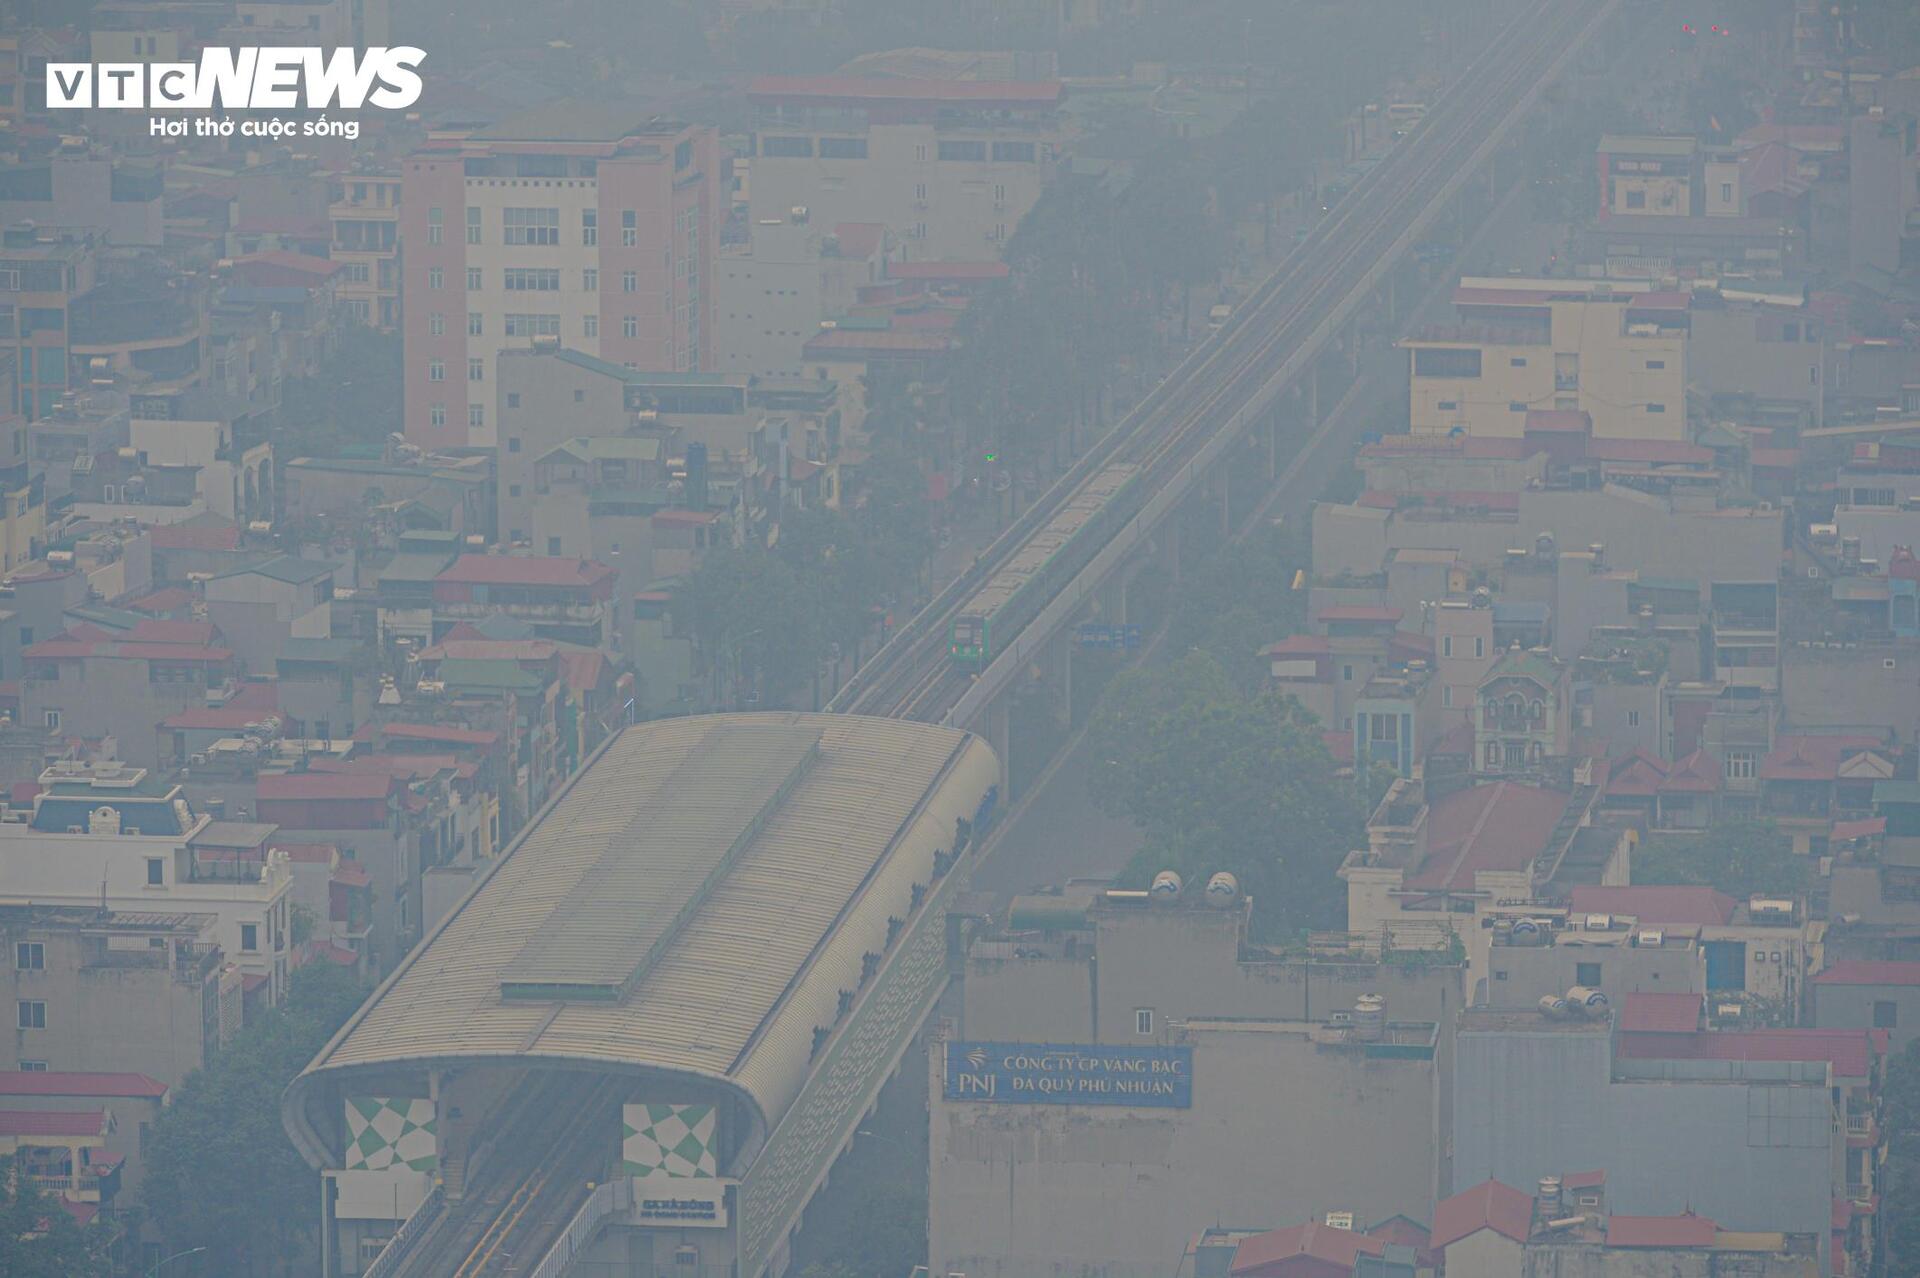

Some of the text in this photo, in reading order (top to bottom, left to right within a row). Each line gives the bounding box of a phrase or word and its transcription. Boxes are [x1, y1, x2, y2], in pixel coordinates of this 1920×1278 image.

[1004, 1053, 1184, 1077] CÔNG TY CP VÀNG BẠC
[960, 1074, 995, 1097] PNJ
